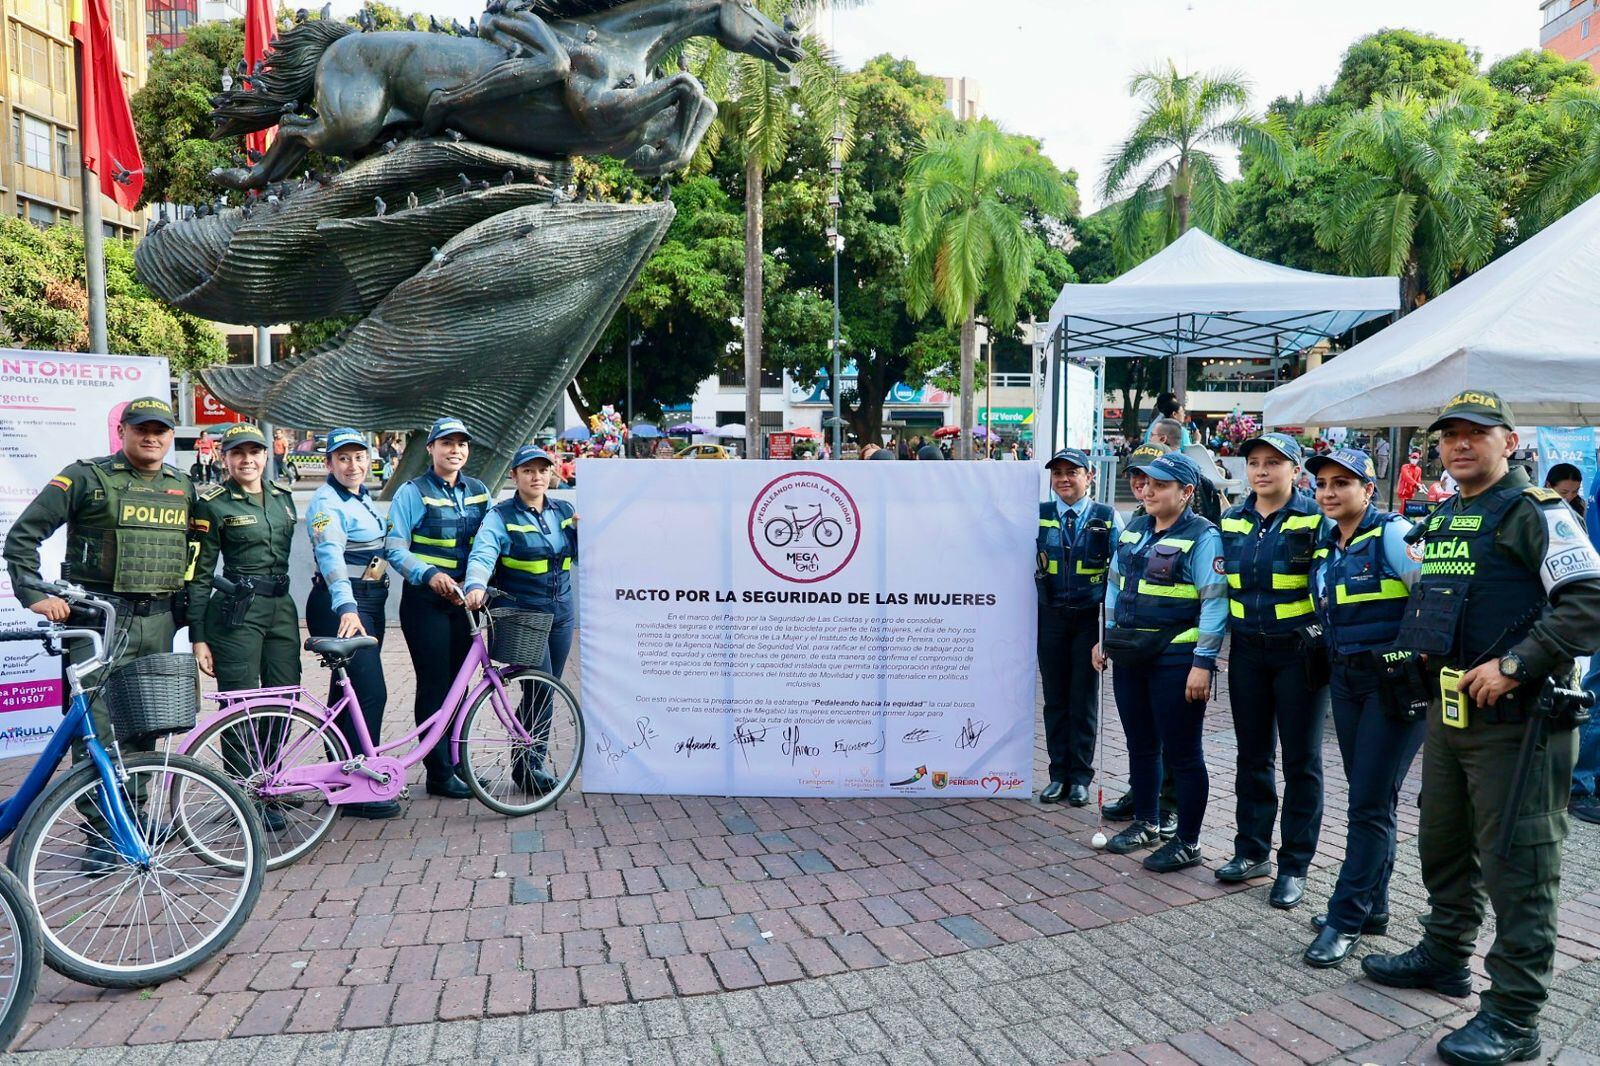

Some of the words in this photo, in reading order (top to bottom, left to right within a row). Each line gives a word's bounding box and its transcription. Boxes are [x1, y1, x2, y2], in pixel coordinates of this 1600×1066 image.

[77, 380, 114, 388] PEREIRA
[1000, 412, 1024, 421] Verde
[1562, 450, 1584, 461] PAZ
[820, 486, 830, 494] LA
[123, 506, 186, 525] POLICIA
[1424, 537, 1469, 559] OLICÍA
[616, 589, 670, 601] PACTO
[676, 590, 710, 602] POR
[716, 590, 737, 602] LA
[742, 591, 842, 603] SEGURIDAD
[848, 592, 870, 604] DE
[876, 593, 908, 604] LAS
[914, 594, 996, 605] MUJERES
[12, 686, 54, 696] Púrpura
[3, 695, 44, 706] 4819507
